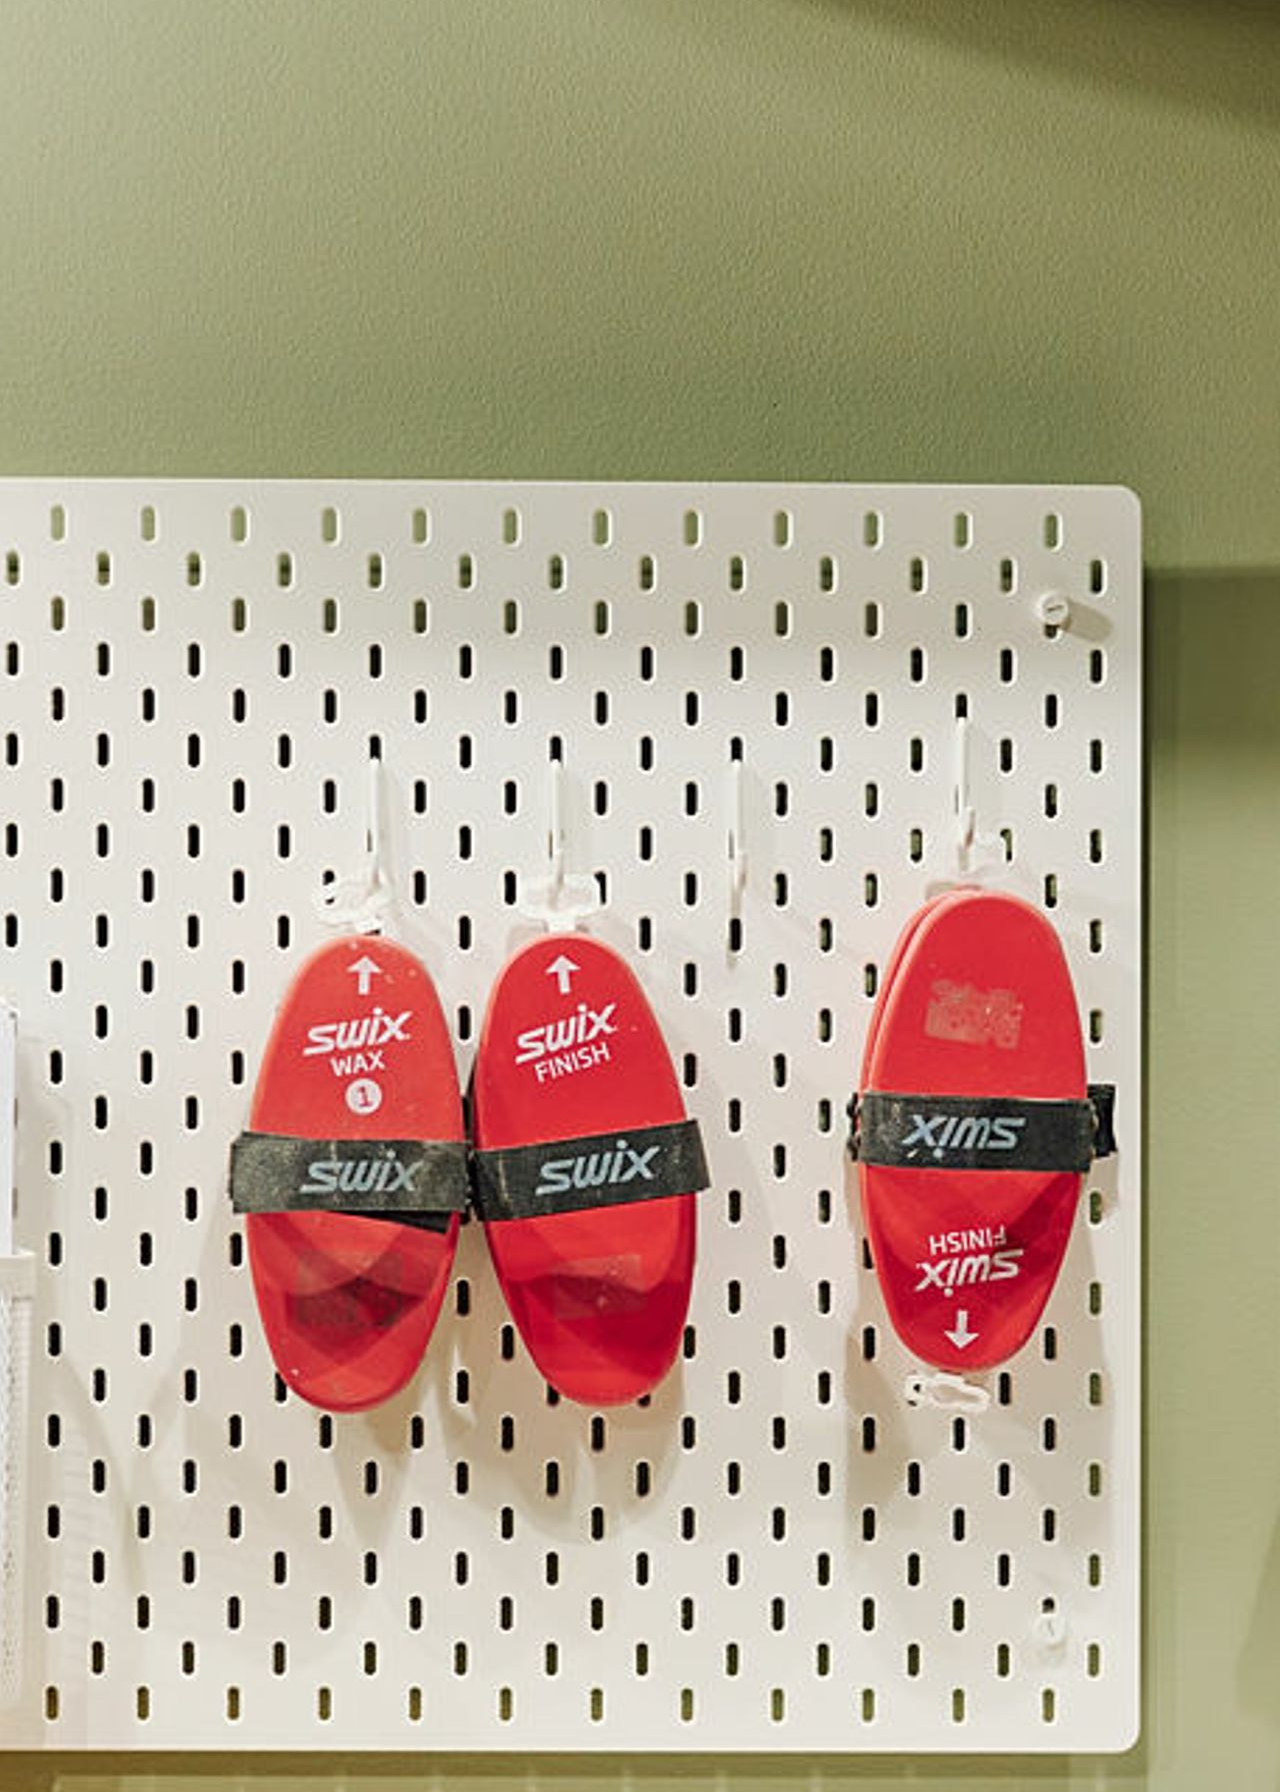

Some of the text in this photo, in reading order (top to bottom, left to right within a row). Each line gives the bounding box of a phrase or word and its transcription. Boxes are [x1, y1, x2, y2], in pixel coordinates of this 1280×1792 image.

[330, 1050, 387, 1077] WAX
[534, 1041, 612, 1083] FINISH
[357, 1087, 374, 1108] 1
[928, 1224, 1008, 1255] FINISH
